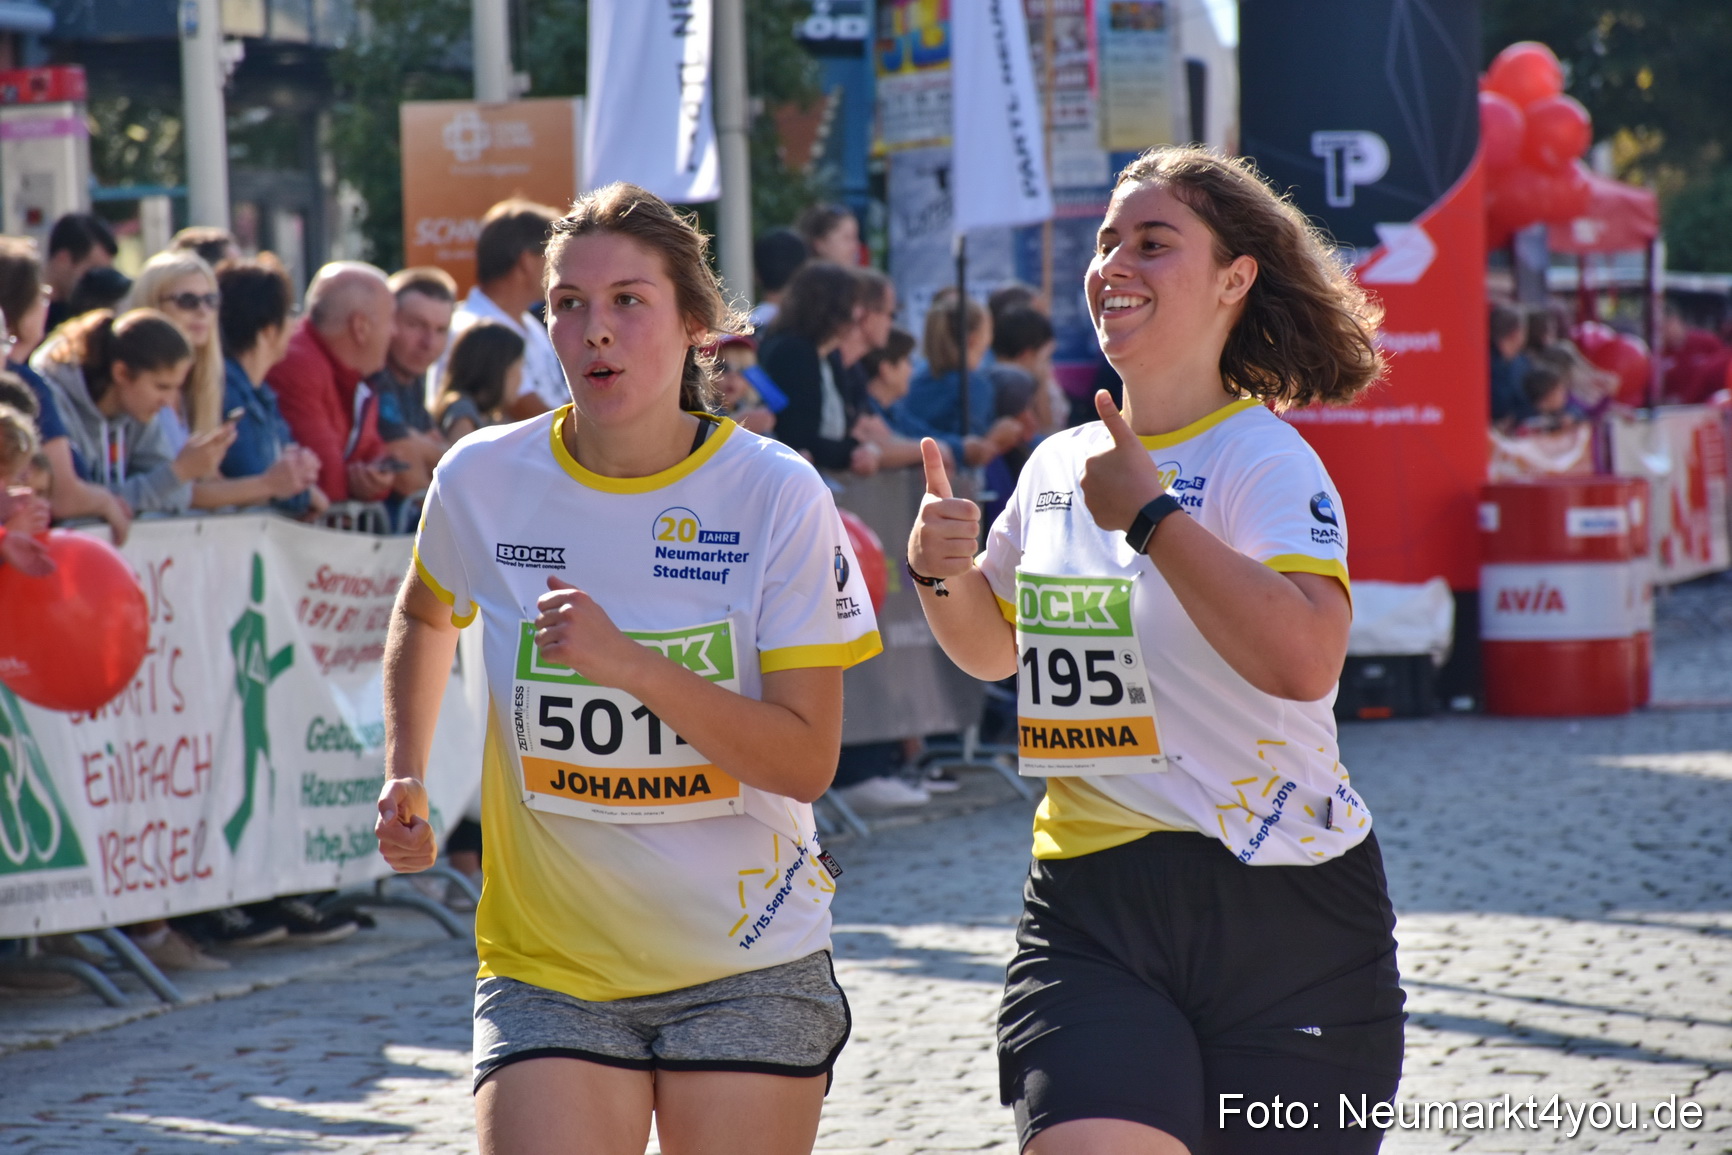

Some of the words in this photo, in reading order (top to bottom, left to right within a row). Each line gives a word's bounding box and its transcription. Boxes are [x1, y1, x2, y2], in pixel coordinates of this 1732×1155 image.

[657, 516, 697, 543] 20
[701, 532, 737, 543] JAHRE
[496, 543, 566, 564] BOCK
[655, 546, 749, 563] Neumarkter
[653, 564, 730, 585] Stadtlauf
[1017, 581, 1119, 630] OCK
[1018, 647, 1124, 707] 195
[539, 695, 690, 755] 501
[1018, 725, 1138, 749] THARINA
[550, 769, 711, 800] JOHANNA
[1272, 781, 1297, 809] 2019
